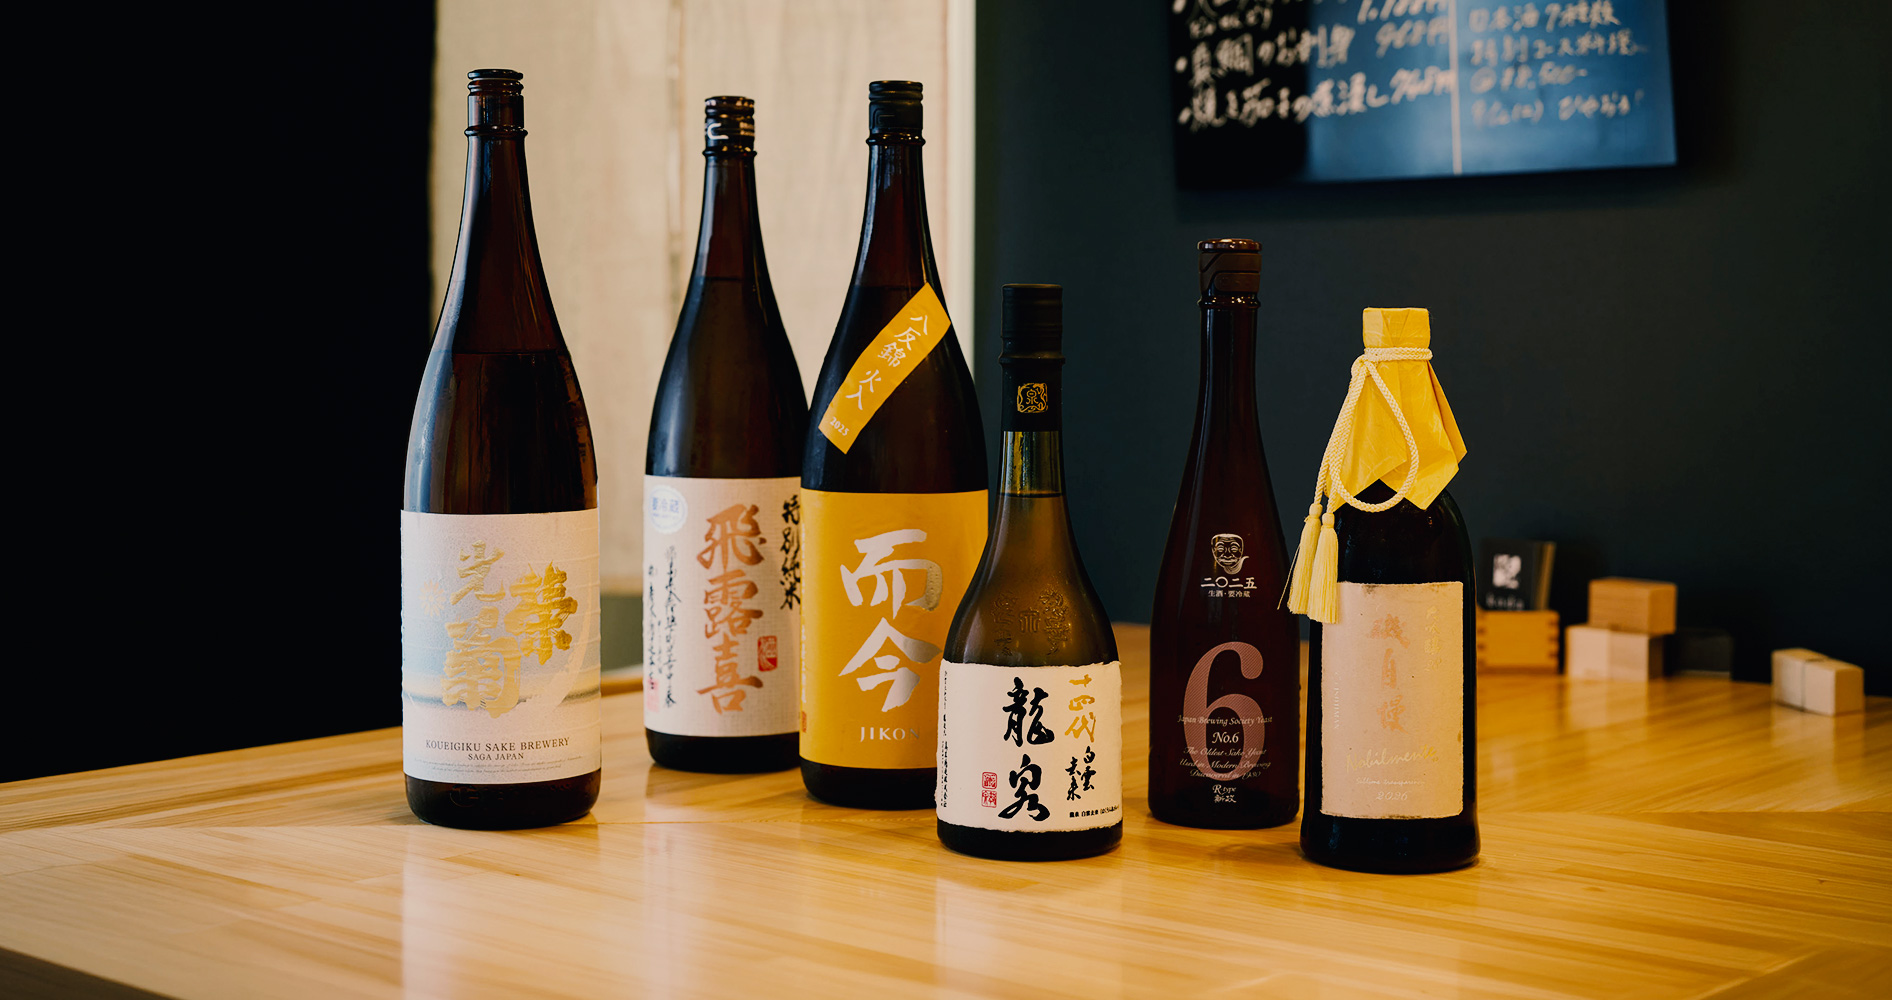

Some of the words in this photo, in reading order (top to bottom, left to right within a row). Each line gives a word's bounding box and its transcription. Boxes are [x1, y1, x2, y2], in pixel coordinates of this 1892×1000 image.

[877, 315, 928, 367] 八反錦
[845, 369, 882, 411] 火入
[829, 416, 850, 437] 2025
[696, 503, 767, 714] 飛露喜
[838, 528, 943, 713] 而今
[1064, 674, 1096, 743] 十四代
[1183, 641, 1265, 781] 6
[425, 739, 481, 751] KOUEIGIKU
[485, 742, 516, 751] SAKE
[520, 737, 570, 751] BREWERY
[495, 752, 524, 760] JAPAN
[860, 726, 920, 742] JIKON
[997, 676, 1055, 822] 龍泉
[1211, 731, 1240, 744] No.6
